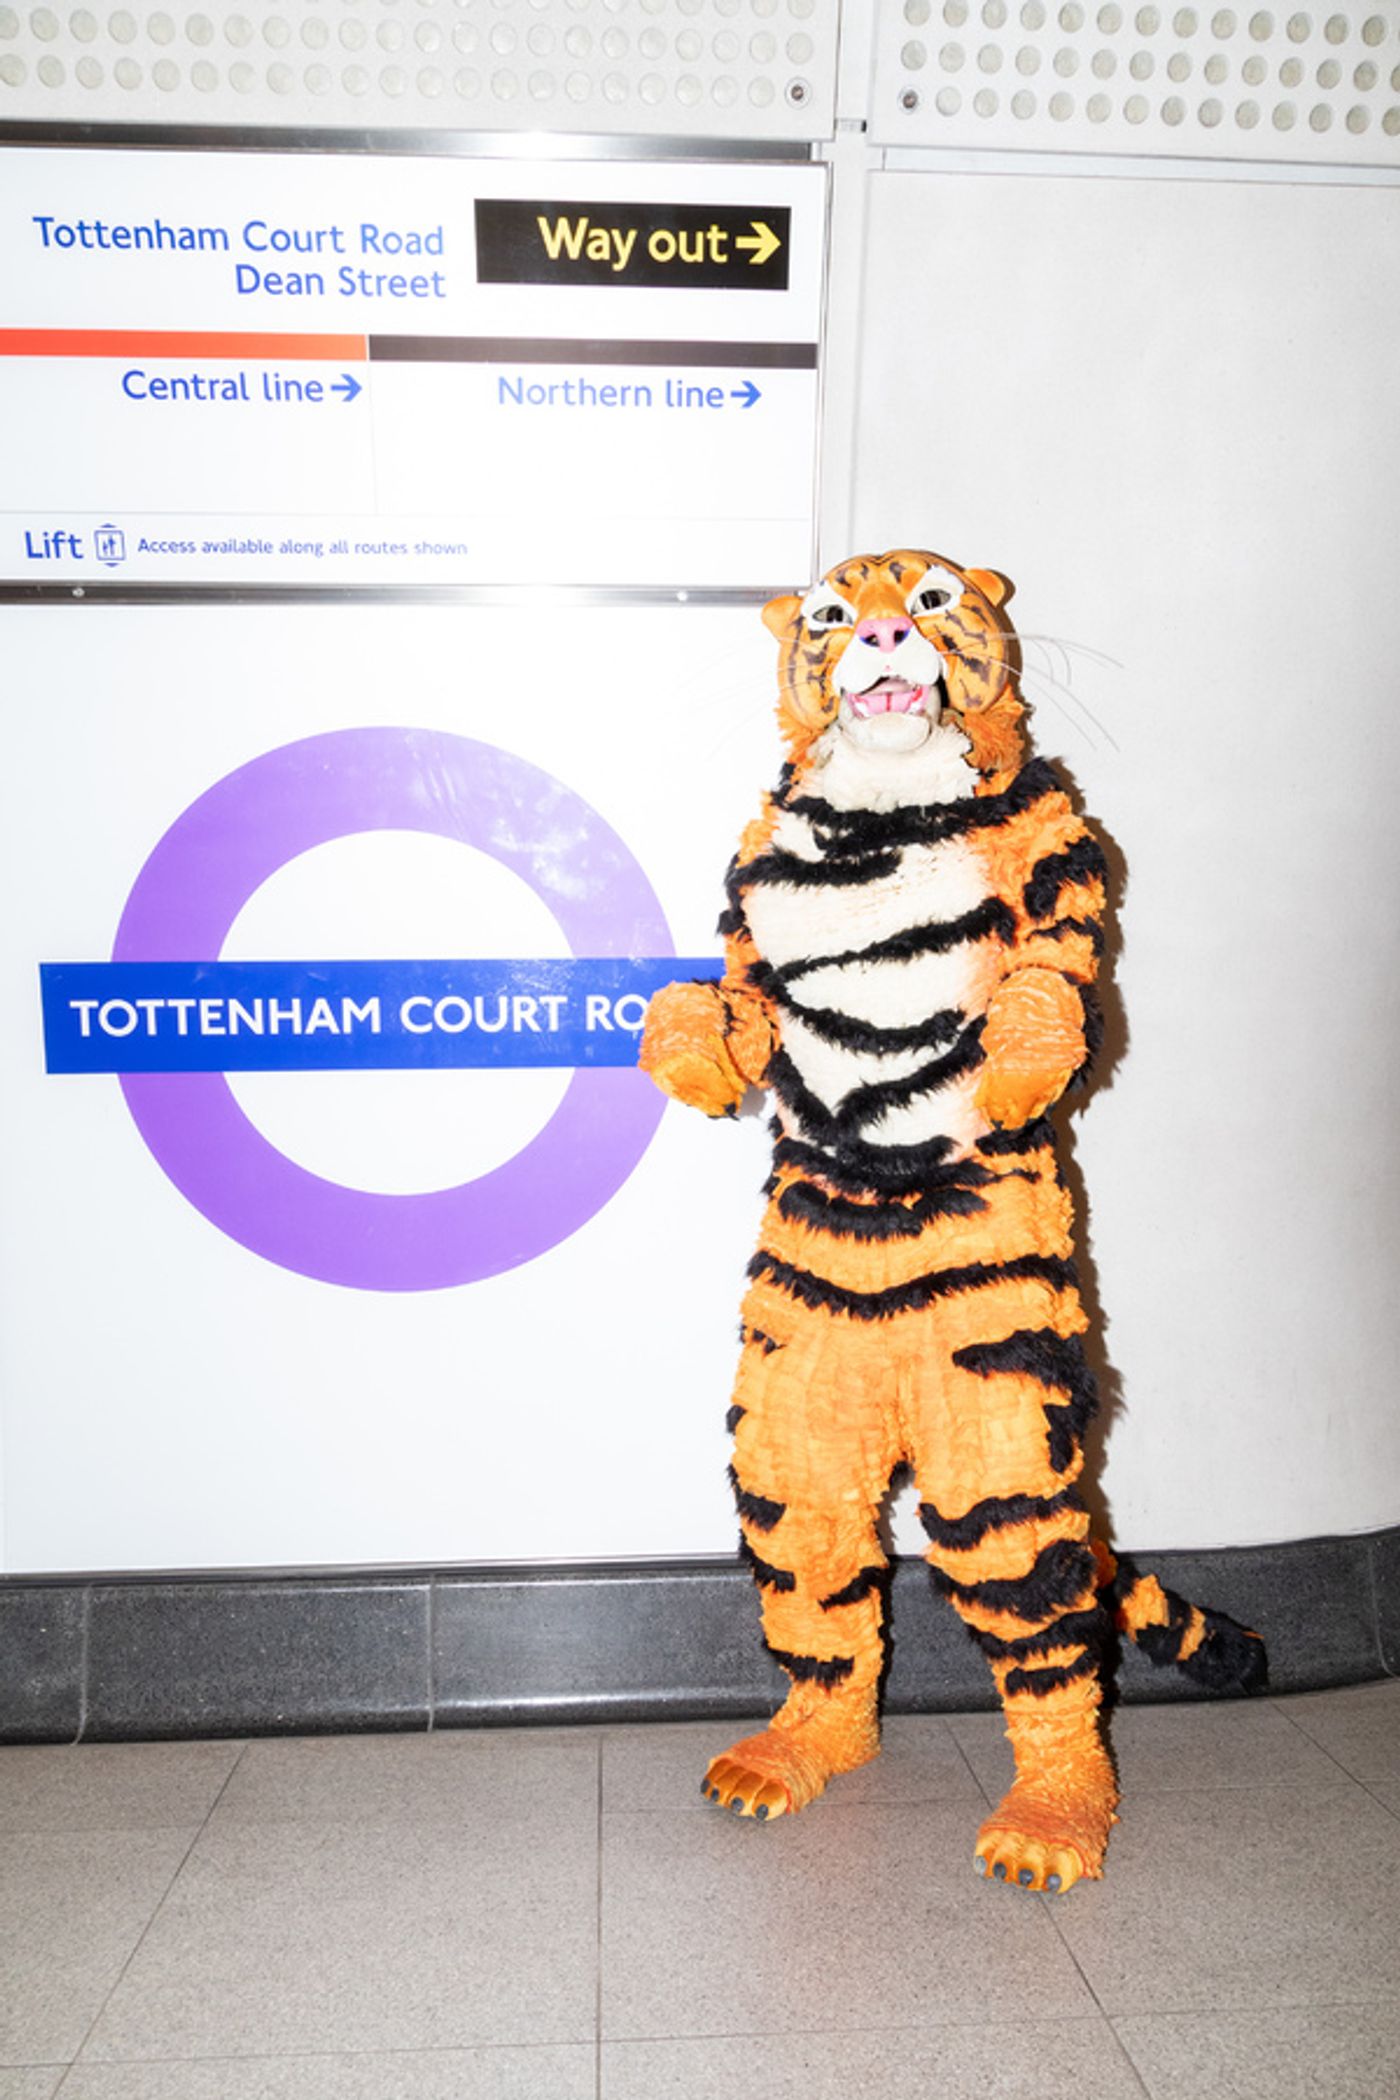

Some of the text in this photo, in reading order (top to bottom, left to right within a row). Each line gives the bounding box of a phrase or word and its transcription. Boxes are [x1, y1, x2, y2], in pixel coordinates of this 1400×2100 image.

[31, 215, 444, 256] Tottenham Court Road
[537, 216, 728, 271] Way out
[235, 262, 446, 298] Dean Street
[121, 369, 324, 403] Central line
[498, 376, 725, 409] Northern line
[24, 530, 84, 560] Lift
[137, 537, 468, 557] Access available along all routes shown
[70, 994, 646, 1038] TOTTENHAM COURT RO
